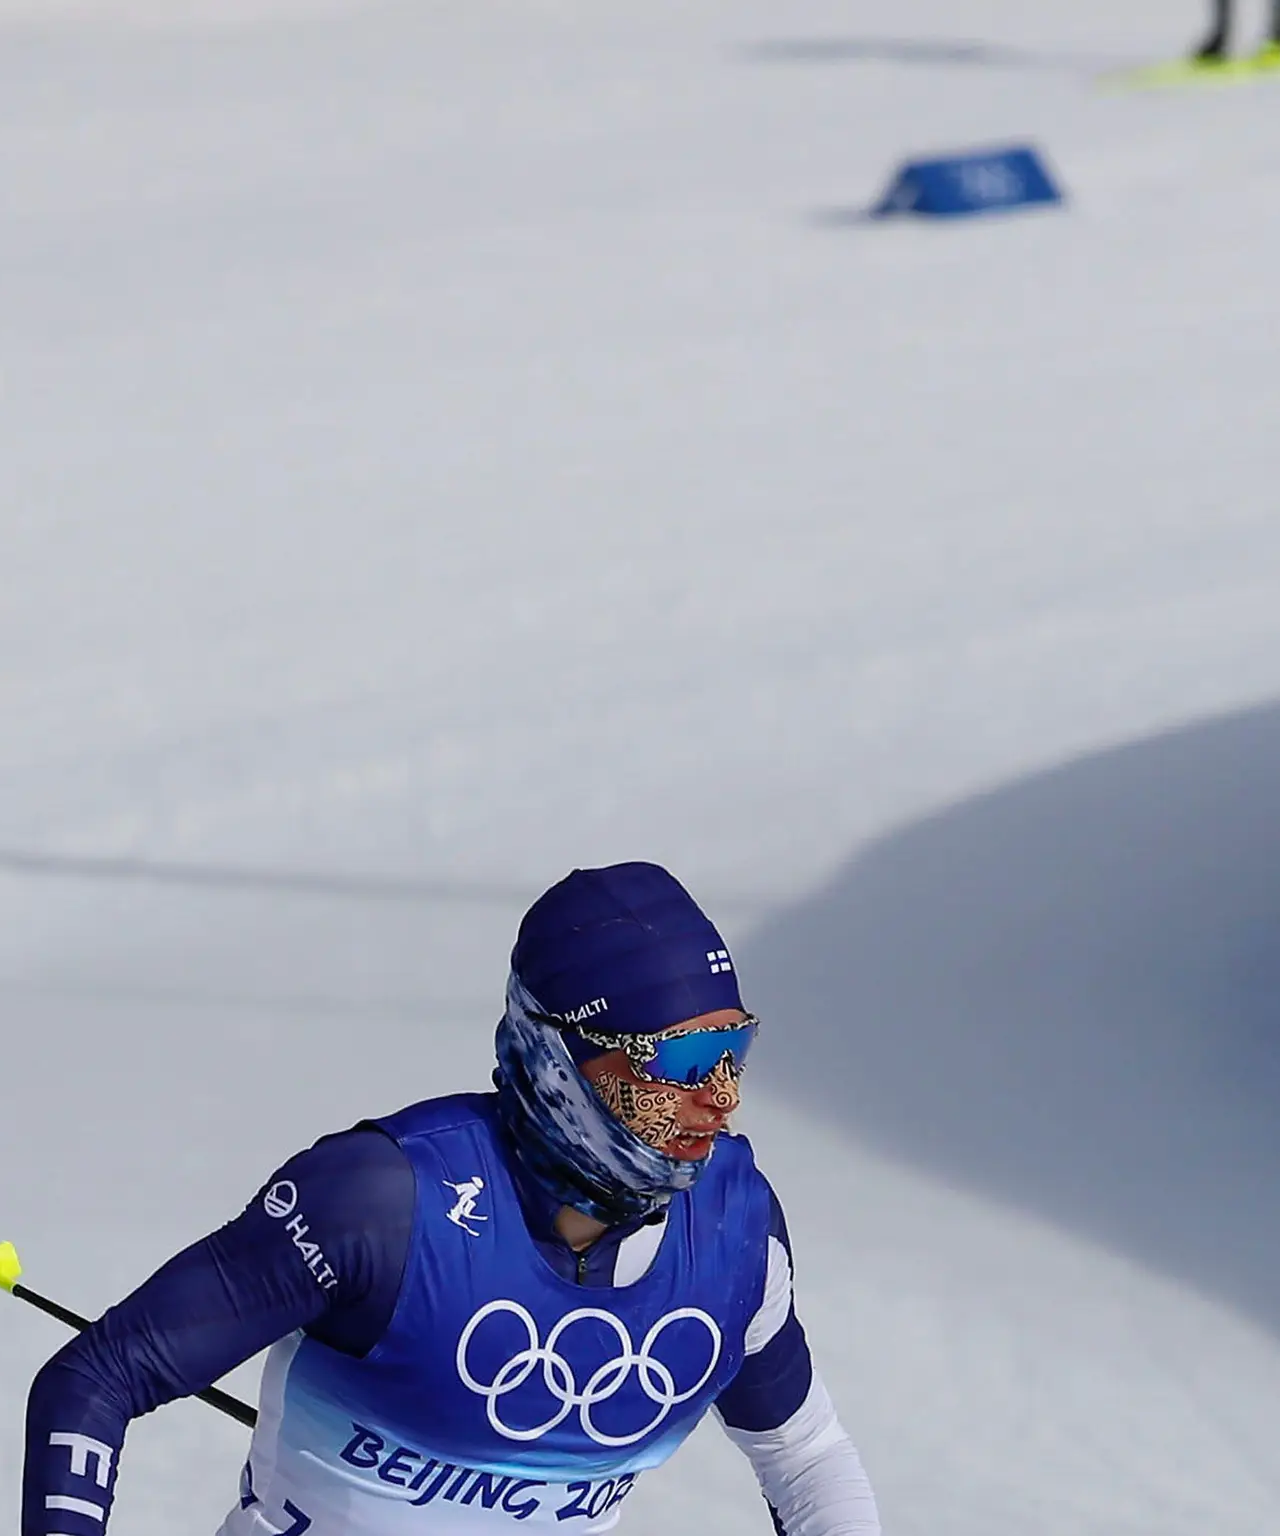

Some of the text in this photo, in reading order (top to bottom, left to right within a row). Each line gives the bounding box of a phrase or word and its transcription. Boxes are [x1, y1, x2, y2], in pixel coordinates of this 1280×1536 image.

[564, 997, 608, 1024] HALTI
[285, 1213, 338, 1289] HALTI
[339, 1420, 547, 1520] BEIJING
